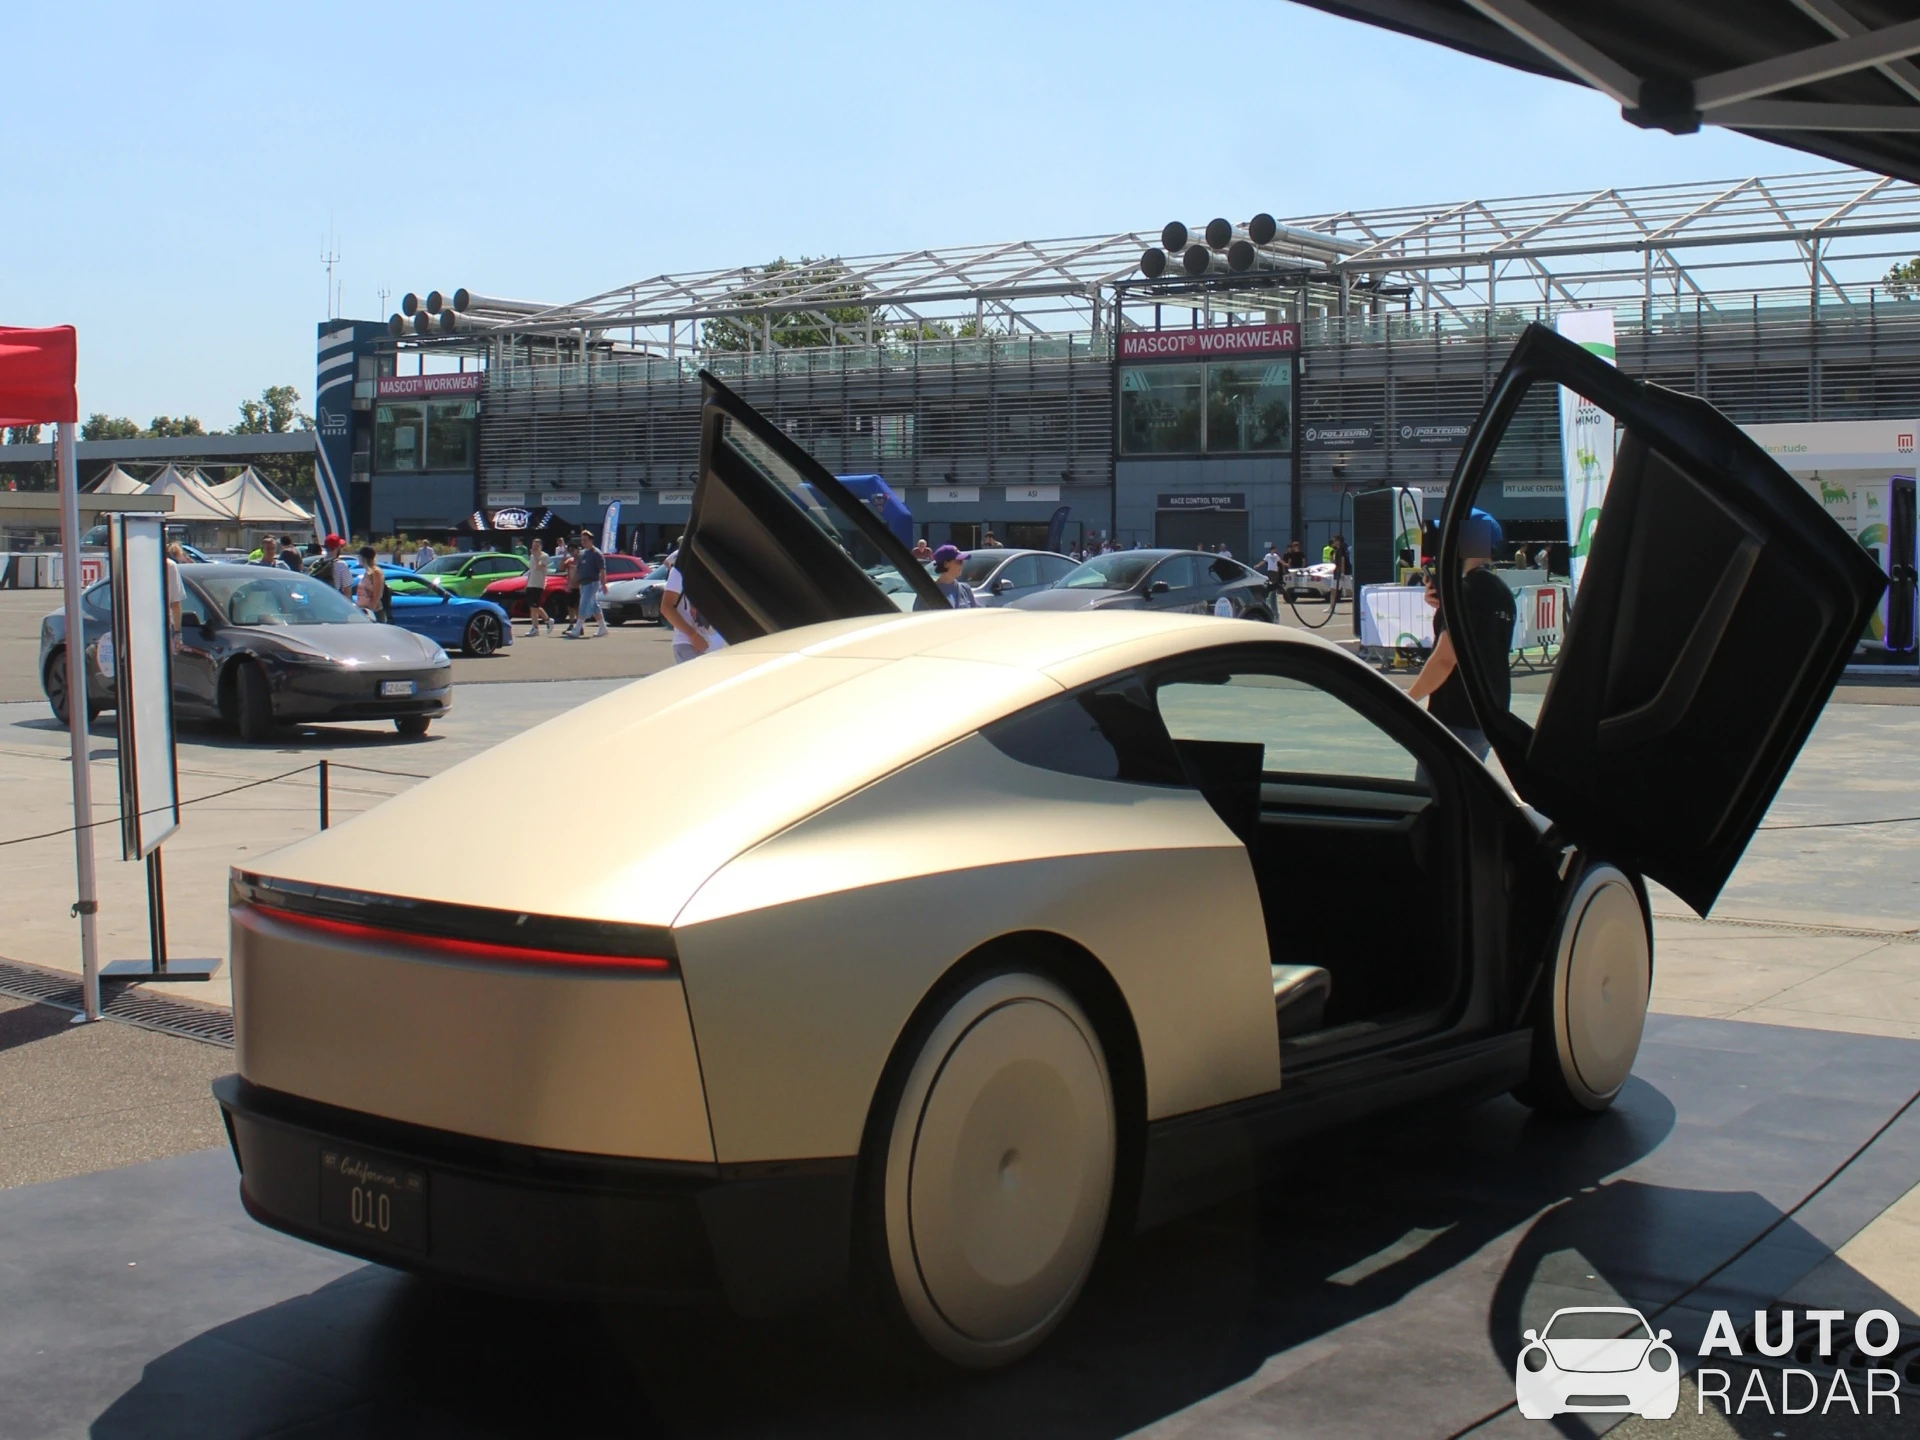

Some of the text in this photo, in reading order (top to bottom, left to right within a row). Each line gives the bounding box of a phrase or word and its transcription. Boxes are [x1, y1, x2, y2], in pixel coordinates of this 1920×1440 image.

[1200, 330, 1294, 350] WORKWEAR
[1575, 415, 1602, 426] MIMO
[321, 427, 348, 436] MONZA
[1762, 444, 1807, 453] lenitude
[1518, 484, 1535, 492] LANE
[1536, 484, 1565, 492] ENTRAN
[341, 1156, 402, 1185] California
[352, 1186, 390, 1232] 010
